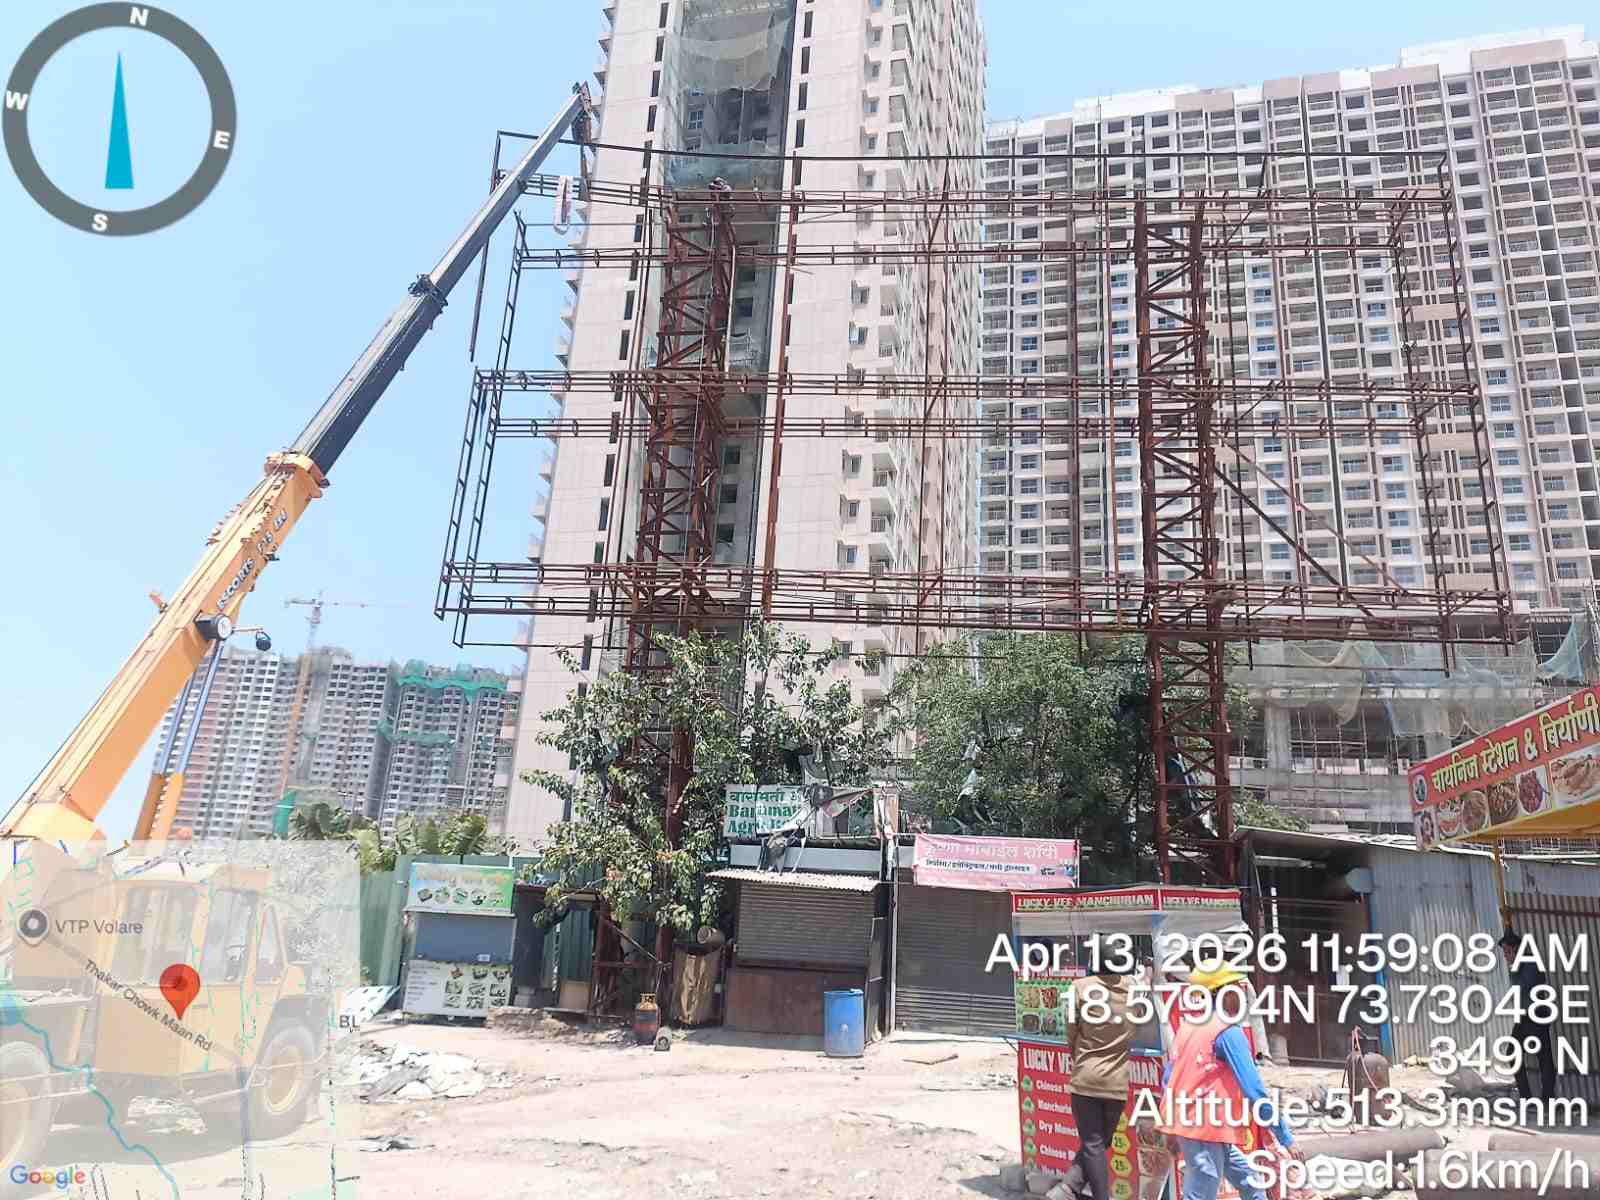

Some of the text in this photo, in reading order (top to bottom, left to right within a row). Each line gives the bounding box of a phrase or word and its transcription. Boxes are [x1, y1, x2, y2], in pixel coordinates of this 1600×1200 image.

[1524, 727, 1538, 761] &
[1018, 897, 1051, 909] LUCKY
[1023, 1047, 1055, 1073] LUCKY
[1056, 1051, 1073, 1075] VE
[1038, 1120, 1053, 1135] Dry
